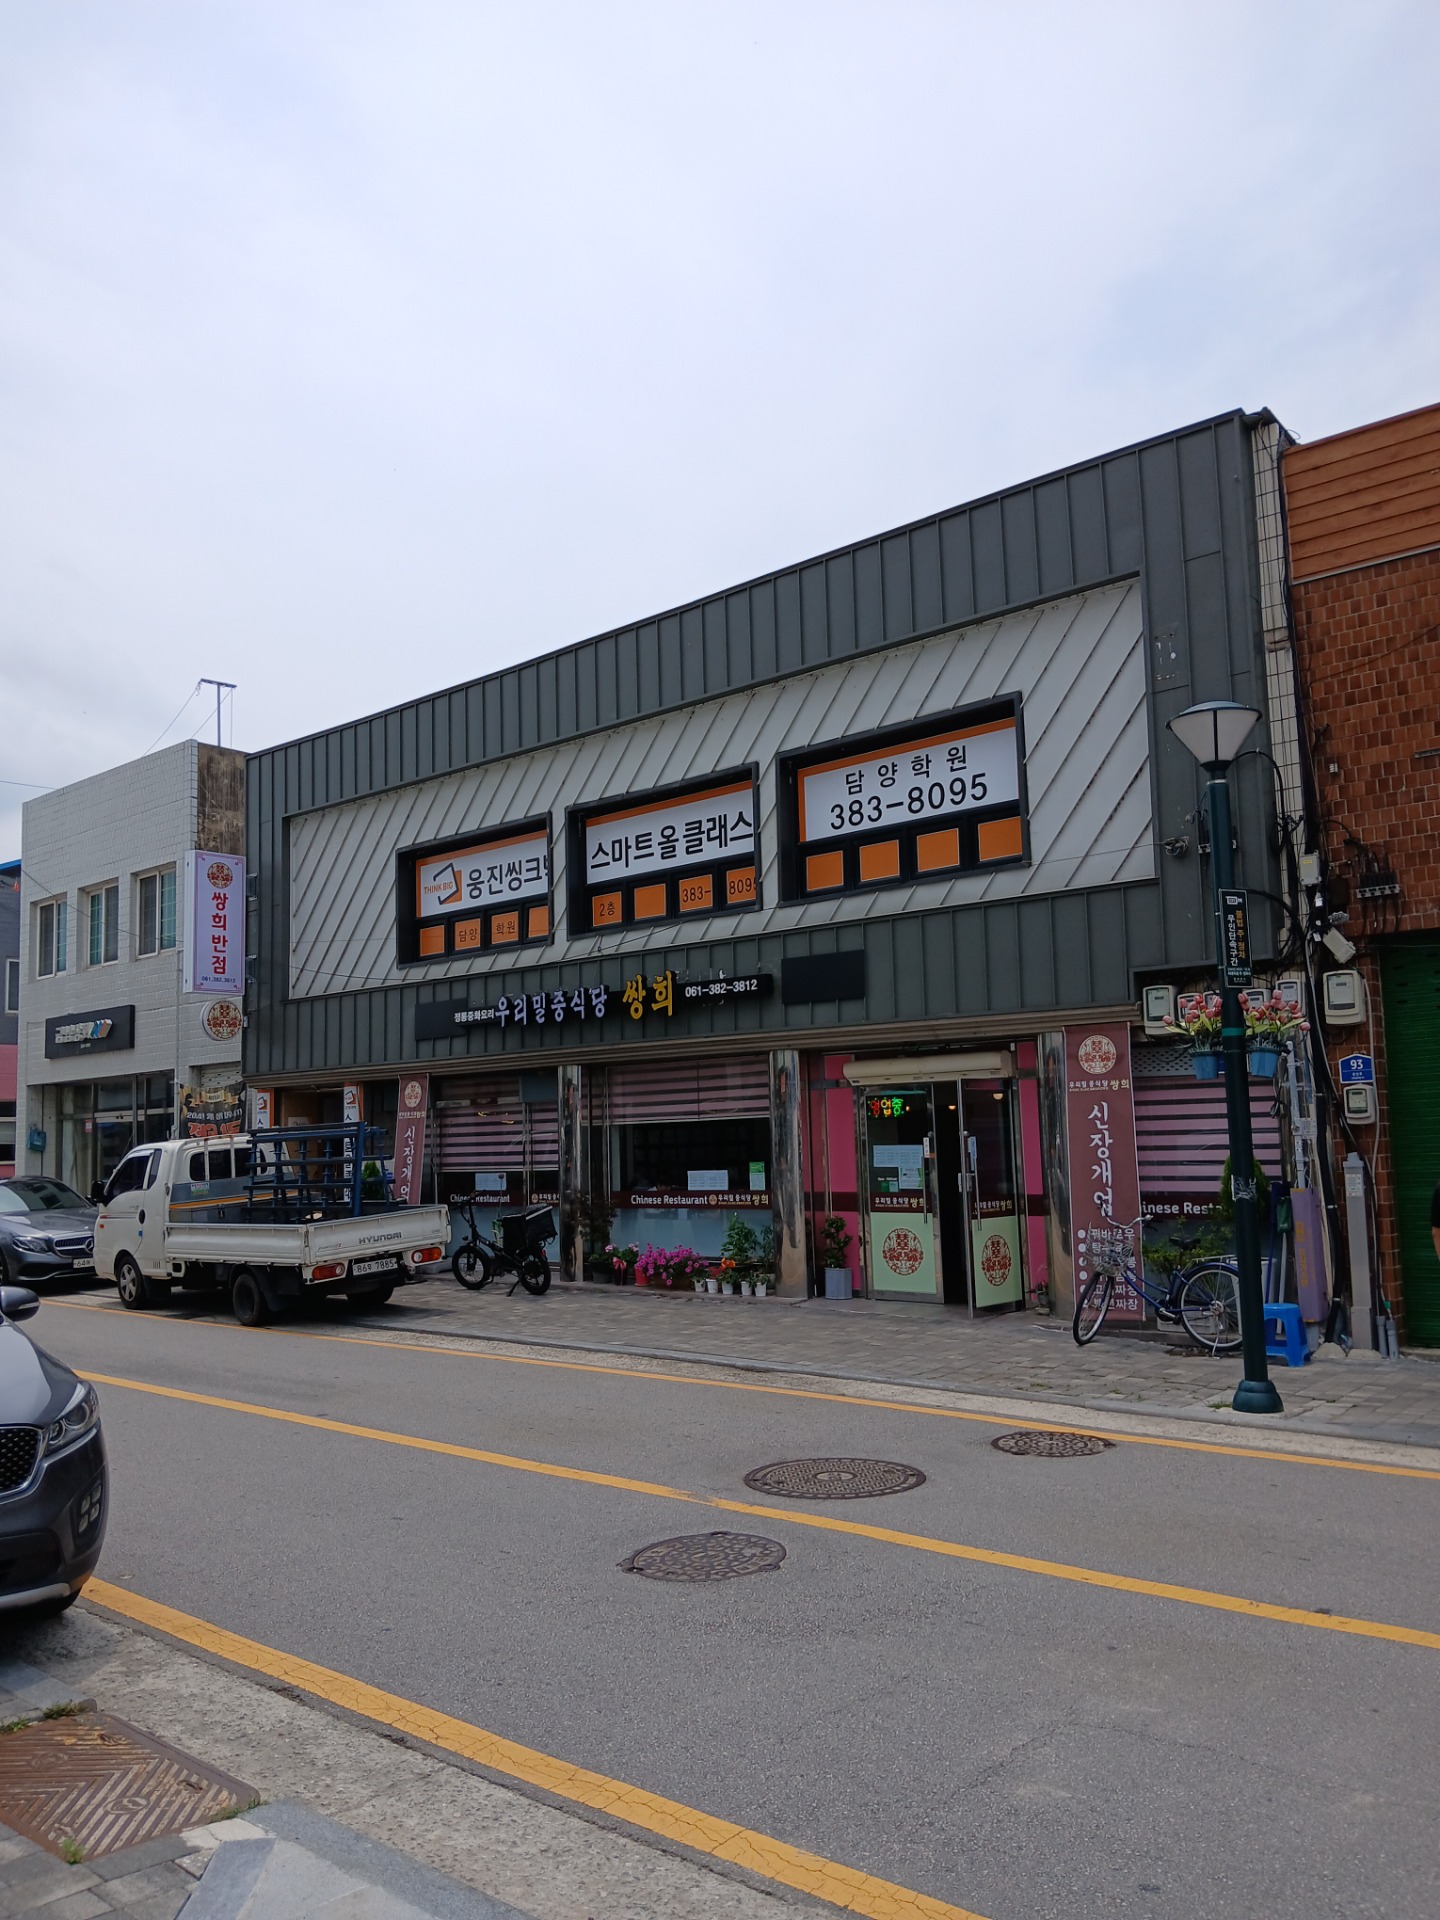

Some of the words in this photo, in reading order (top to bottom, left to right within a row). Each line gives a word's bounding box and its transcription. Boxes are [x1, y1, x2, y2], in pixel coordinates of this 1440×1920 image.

[830, 772, 988, 830] 383-8095
[424, 883, 442, 895] THINK
[442, 881, 454, 891] BIG
[682, 886, 712, 903] 383-
[599, 901, 616, 917] 2층
[211, 891, 228, 975] 쌍희반점
[458, 928, 478, 943] 담양
[684, 979, 758, 998] 061-382-3812
[454, 1008, 495, 1023] 정통중화요리
[622, 970, 673, 1020] 쌍희
[1350, 1059, 1363, 1070] 93
[1109, 1079, 1130, 1091] 쌍희
[870, 1098, 902, 1116] 영업중
[1086, 1100, 1114, 1218] 신장개업
[631, 1194, 662, 1205] Chinese
[663, 1194, 708, 1205] Restaurant
[752, 1194, 769, 1206] 쌍희
[1141, 1201, 1180, 1214] inese
[358, 1231, 402, 1245] HYUNDAI
[375, 1259, 394, 1270] 7885
